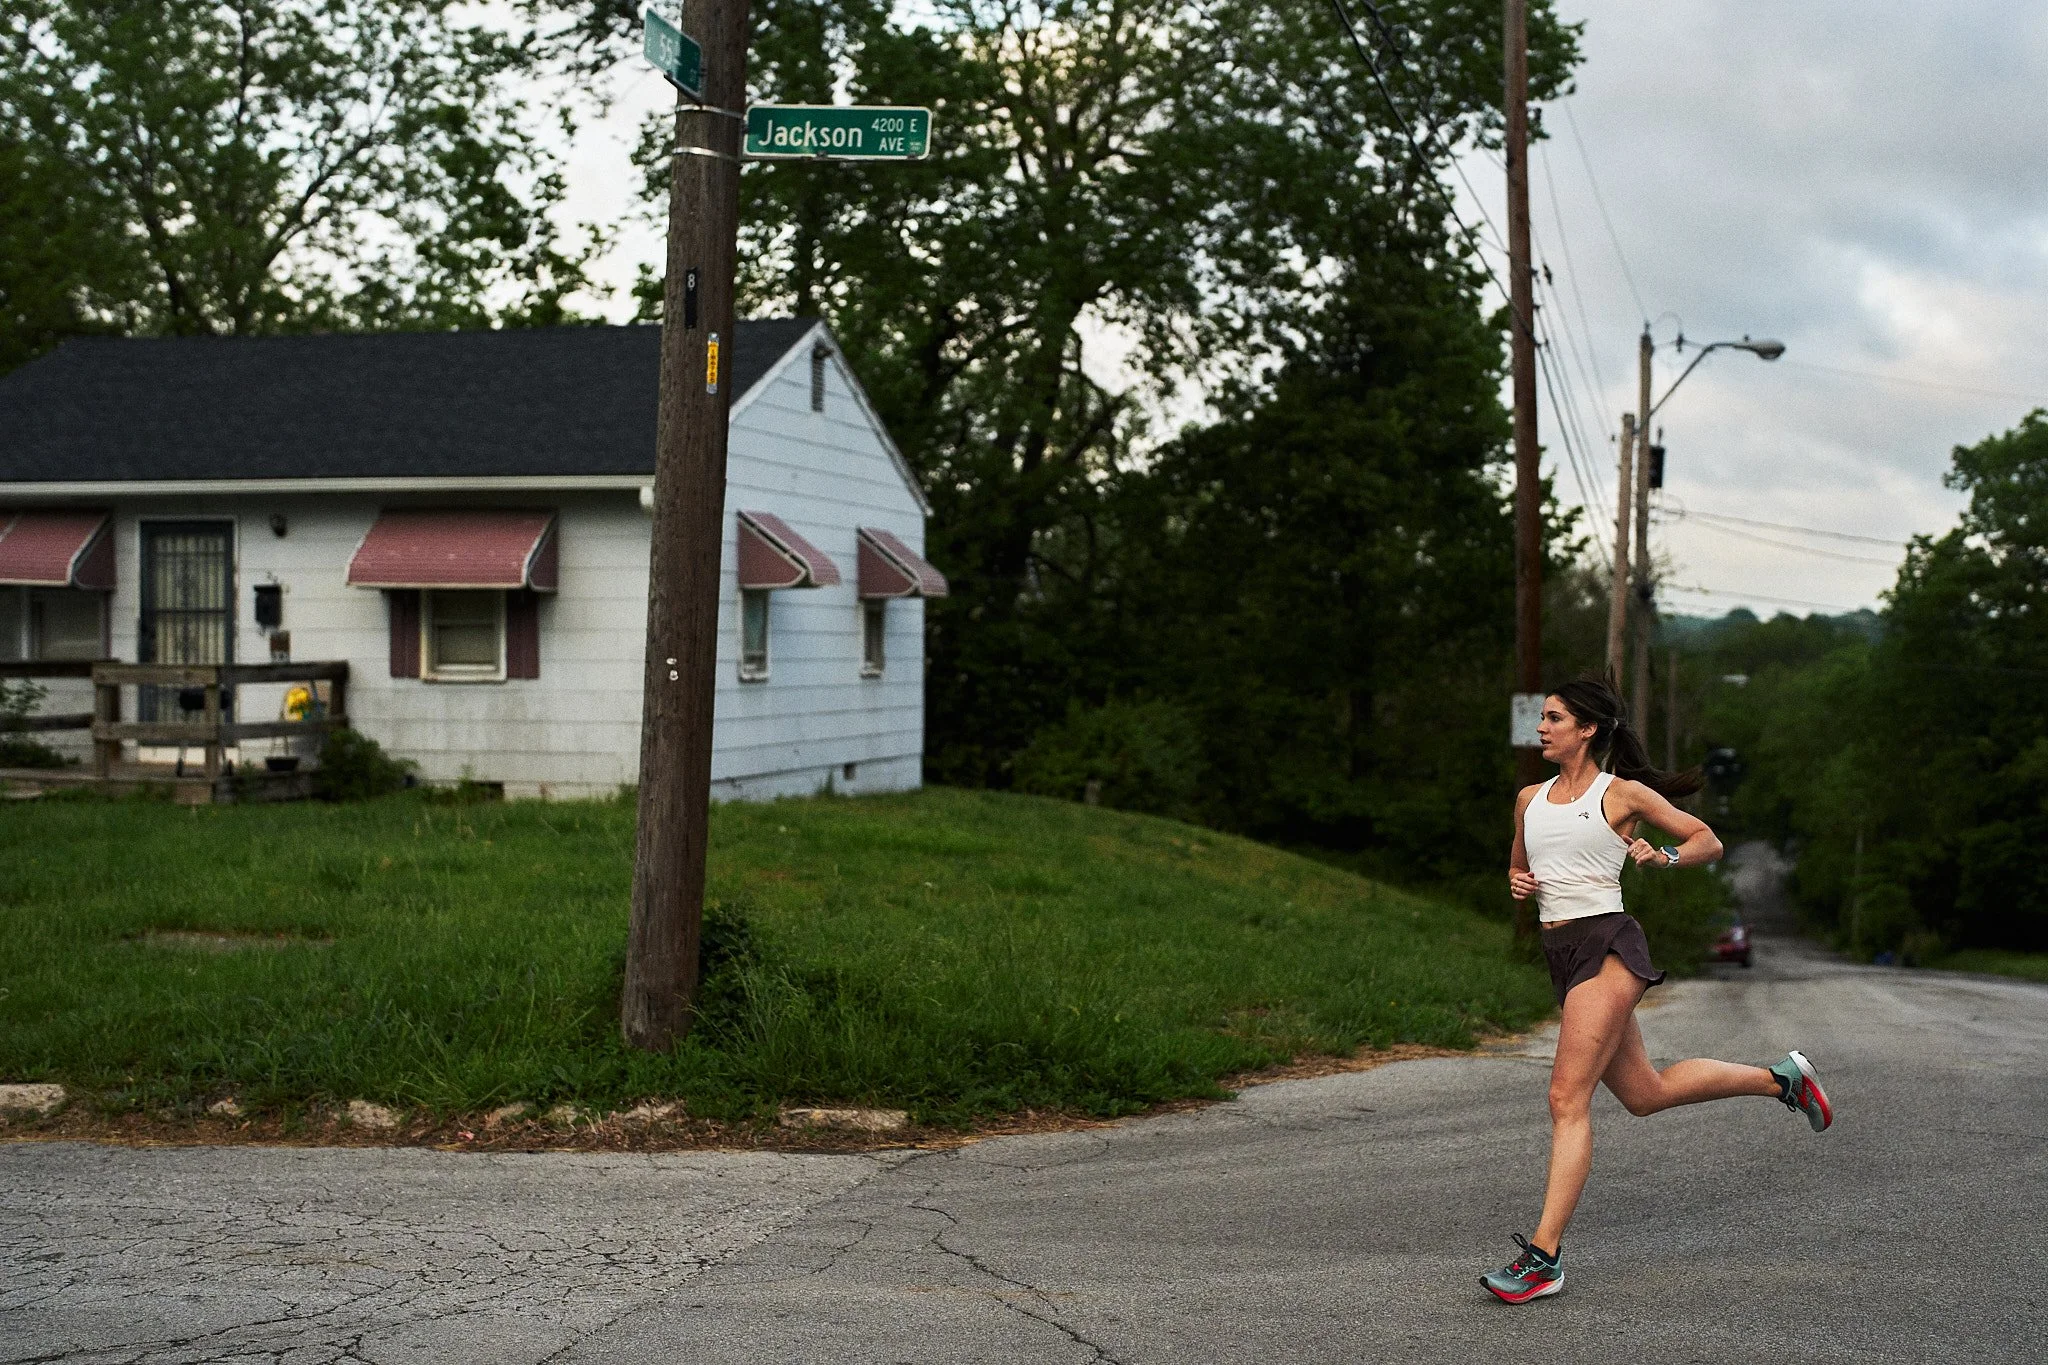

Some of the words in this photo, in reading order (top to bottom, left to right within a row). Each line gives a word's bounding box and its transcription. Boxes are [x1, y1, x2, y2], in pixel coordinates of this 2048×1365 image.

[871, 118, 904, 132] 4200
[910, 119, 918, 132] E
[758, 120, 862, 147] Jackson
[878, 137, 905, 152] AVE
